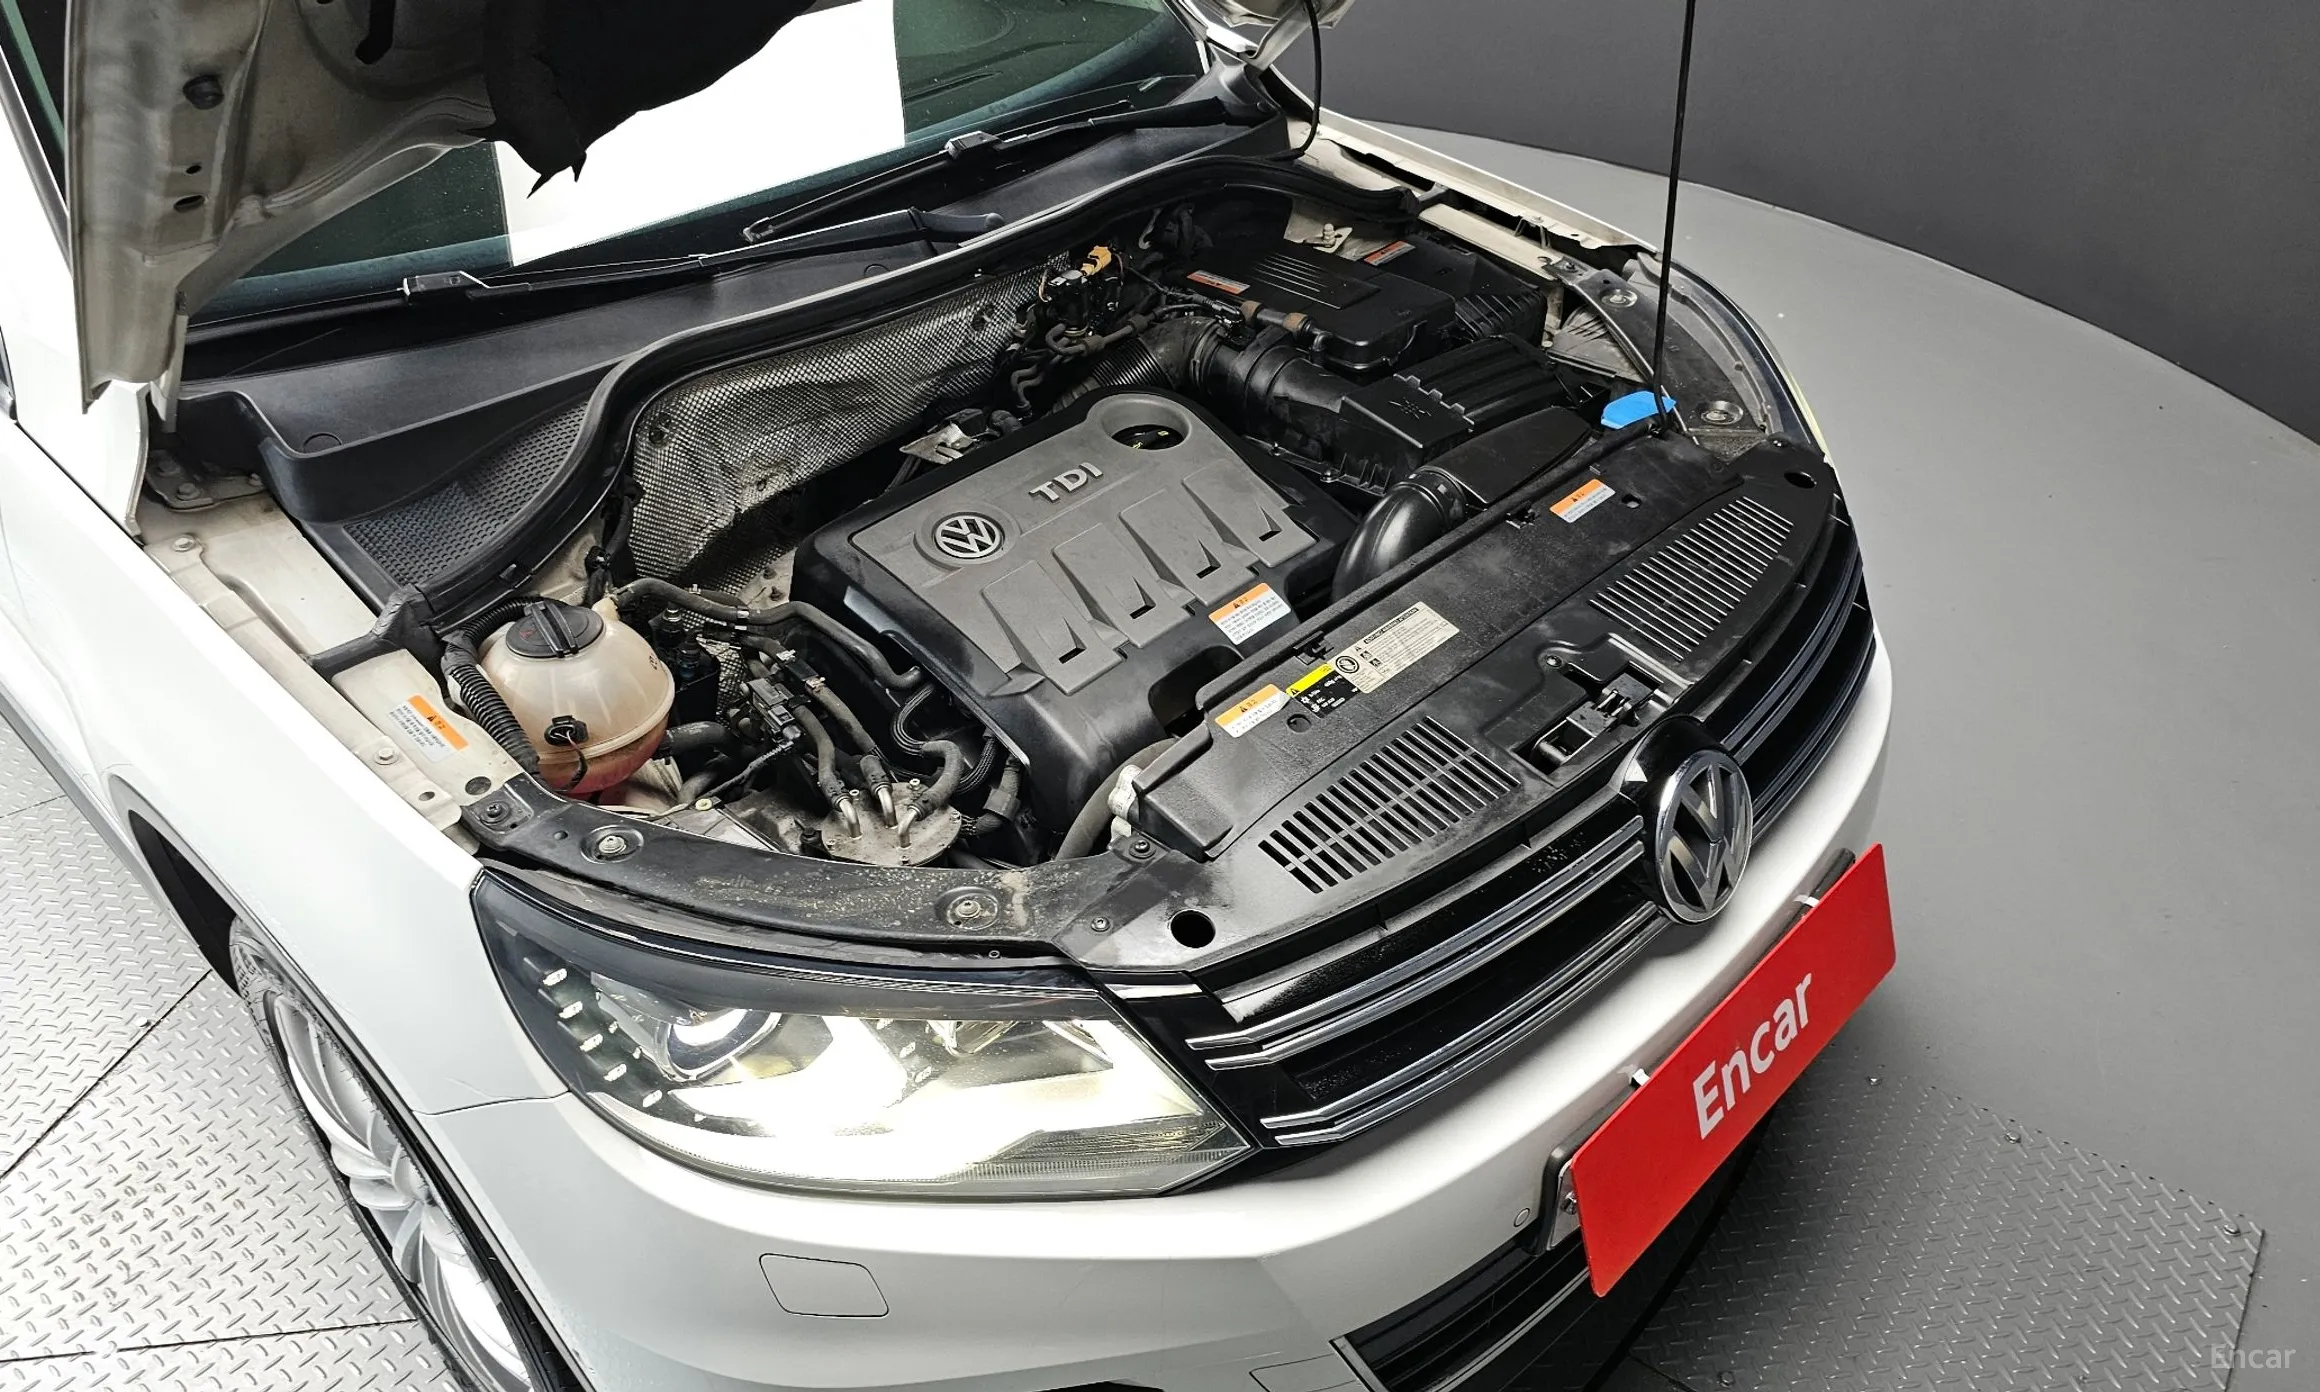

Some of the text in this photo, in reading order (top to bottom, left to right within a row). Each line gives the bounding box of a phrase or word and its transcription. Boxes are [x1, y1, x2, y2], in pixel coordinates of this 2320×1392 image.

[1029, 462, 1103, 502] TDI
[936, 515, 1001, 558] VW
[1692, 972, 1812, 1140] Encar
